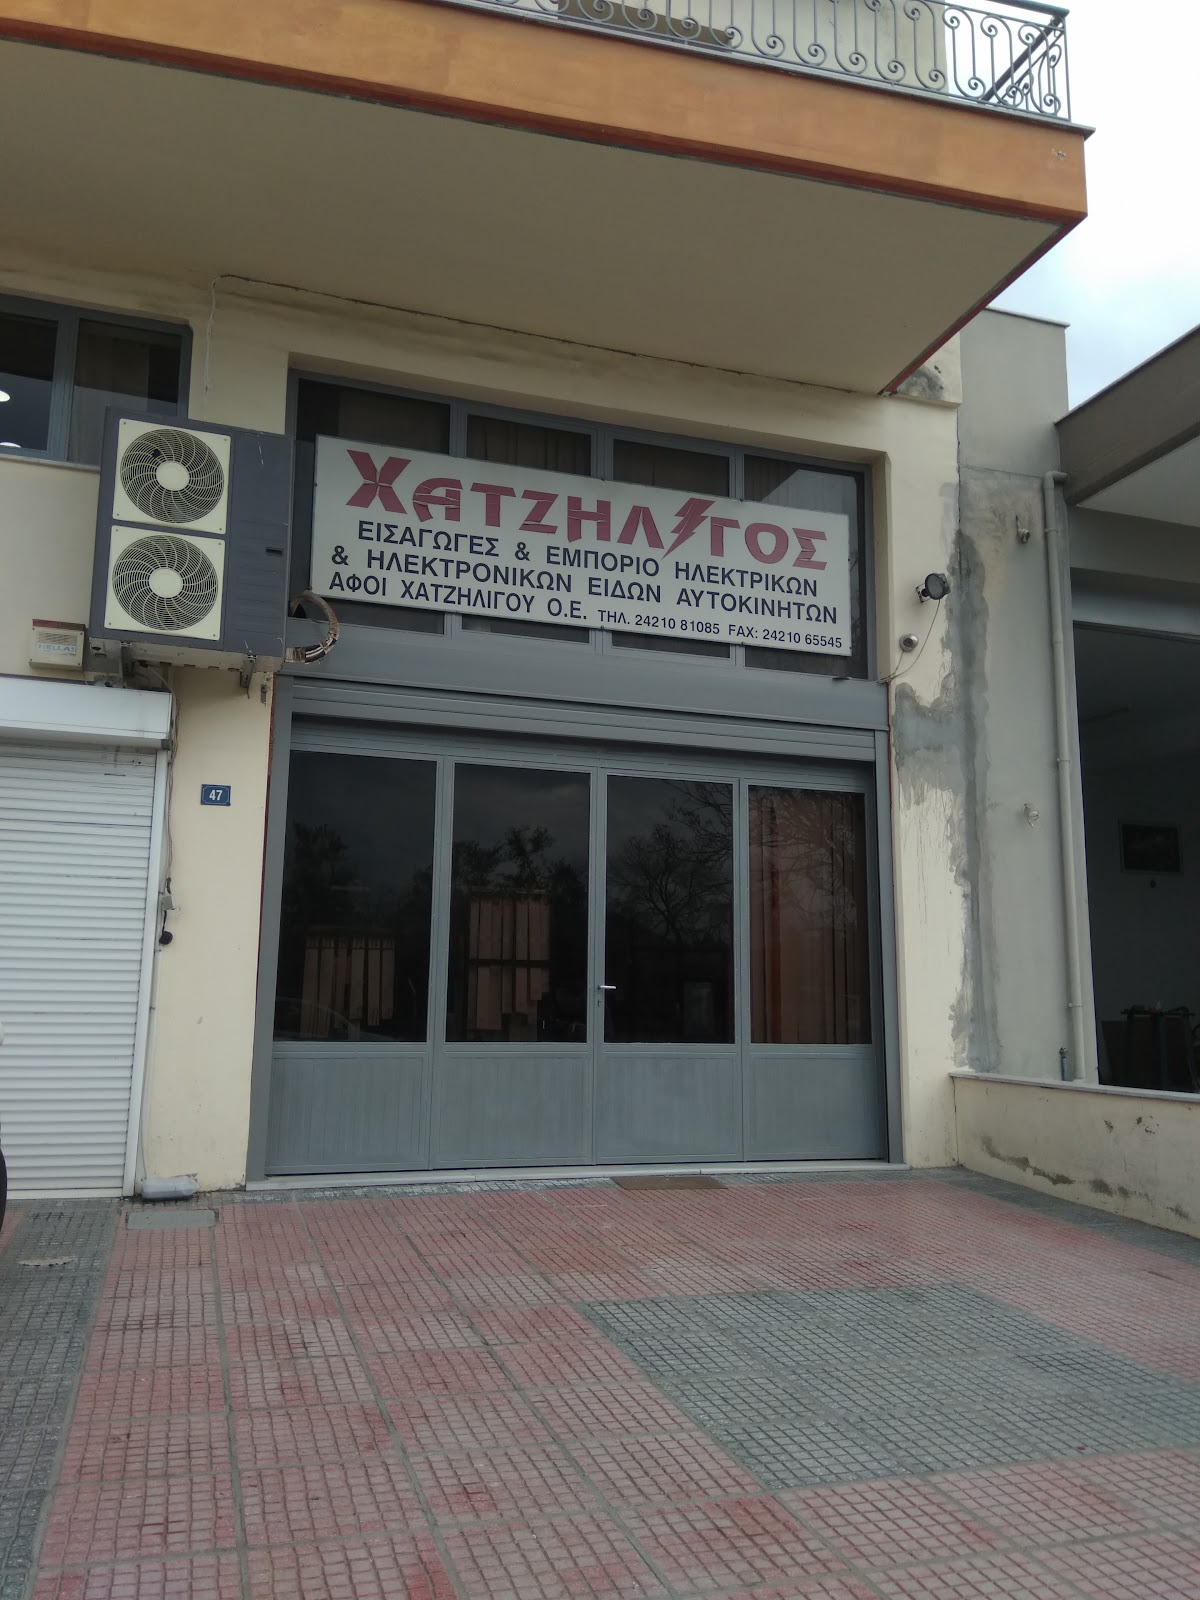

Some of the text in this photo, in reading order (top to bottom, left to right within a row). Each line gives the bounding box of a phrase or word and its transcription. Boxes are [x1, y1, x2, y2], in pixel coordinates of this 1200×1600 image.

[331, 545, 837, 625] & ΗΛΕΚΤΡΟΝΙΚΩΝ ΕΙΔΩΝ ΑΥΤΟΚΙΝΗΤΩΝ
[358, 520, 818, 598] ΕΙΣΑΓΩΓΕΣ & ΕΜΠΟΡΙΟ ΗΛΕΚΤΡΙΚΩΝ
[328, 571, 842, 649] ΑΦΟΙ ΧΑΤΖΗΛΙΓΟΥ Ο.Ε. ΤΗΛ. 24210 81085 FAX: 24210 65545
[208, 789, 223, 801] 47
